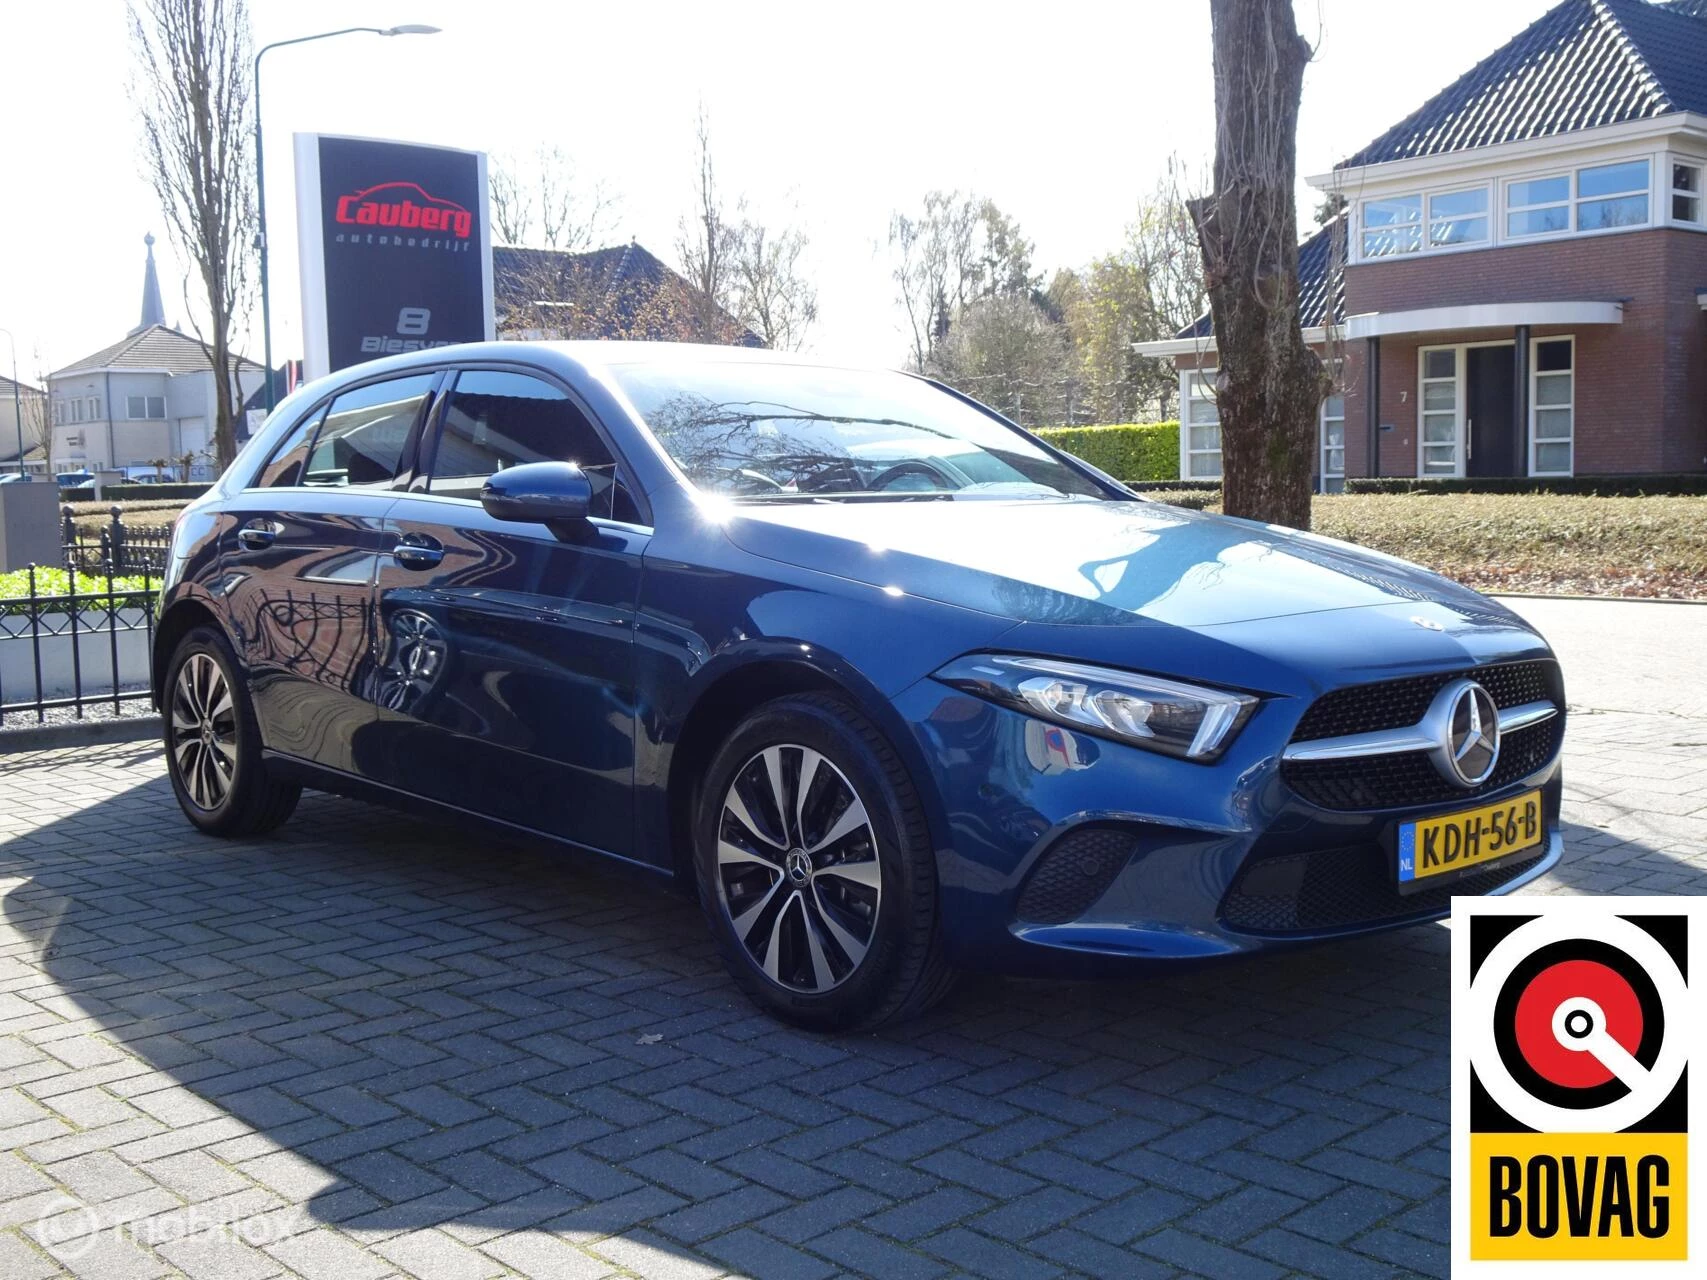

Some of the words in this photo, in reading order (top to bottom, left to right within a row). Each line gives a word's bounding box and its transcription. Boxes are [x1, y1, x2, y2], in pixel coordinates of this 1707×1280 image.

[336, 196, 471, 238] Cauberg
[336, 234, 470, 251] autobedrijf
[1400, 391, 1408, 403] 7
[1422, 801, 1537, 868] KDH-56-B
[1400, 859, 1413, 871] NL
